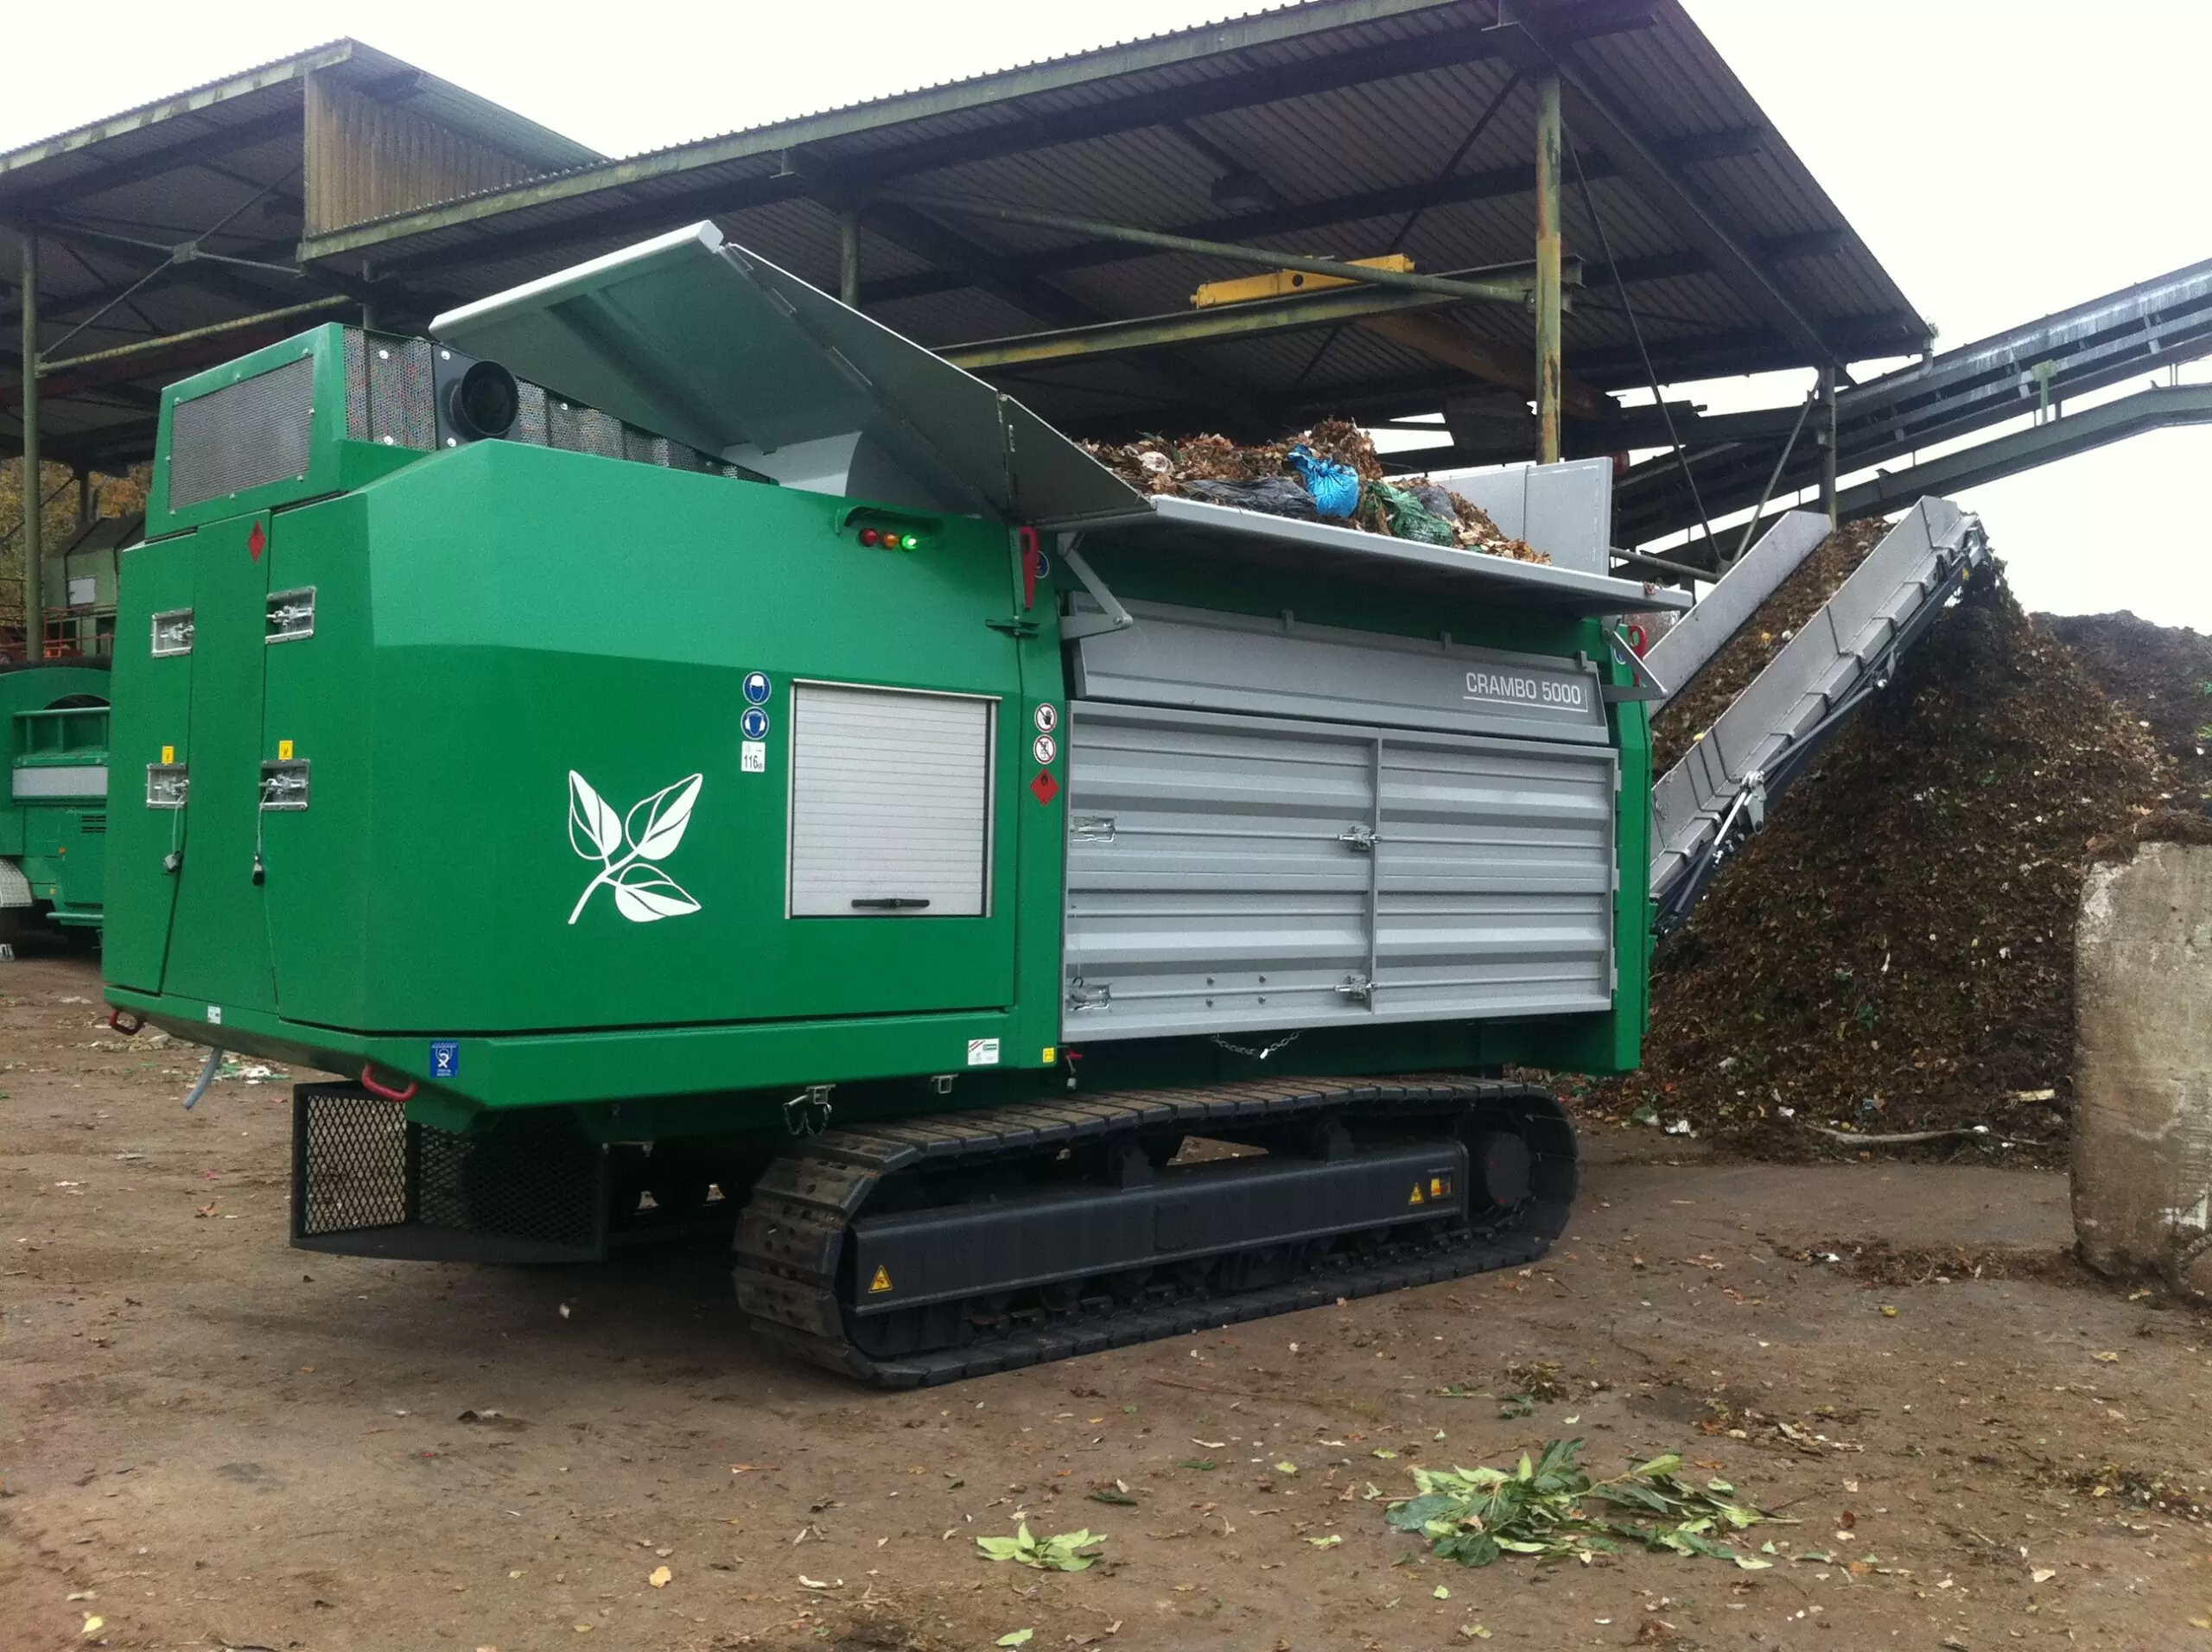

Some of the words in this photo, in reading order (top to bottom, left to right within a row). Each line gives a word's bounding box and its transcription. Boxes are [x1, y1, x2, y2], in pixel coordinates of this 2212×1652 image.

[1465, 672, 1537, 700] CRAMBO
[1541, 681, 1581, 705] 5000
[744, 754, 758, 769] 116
